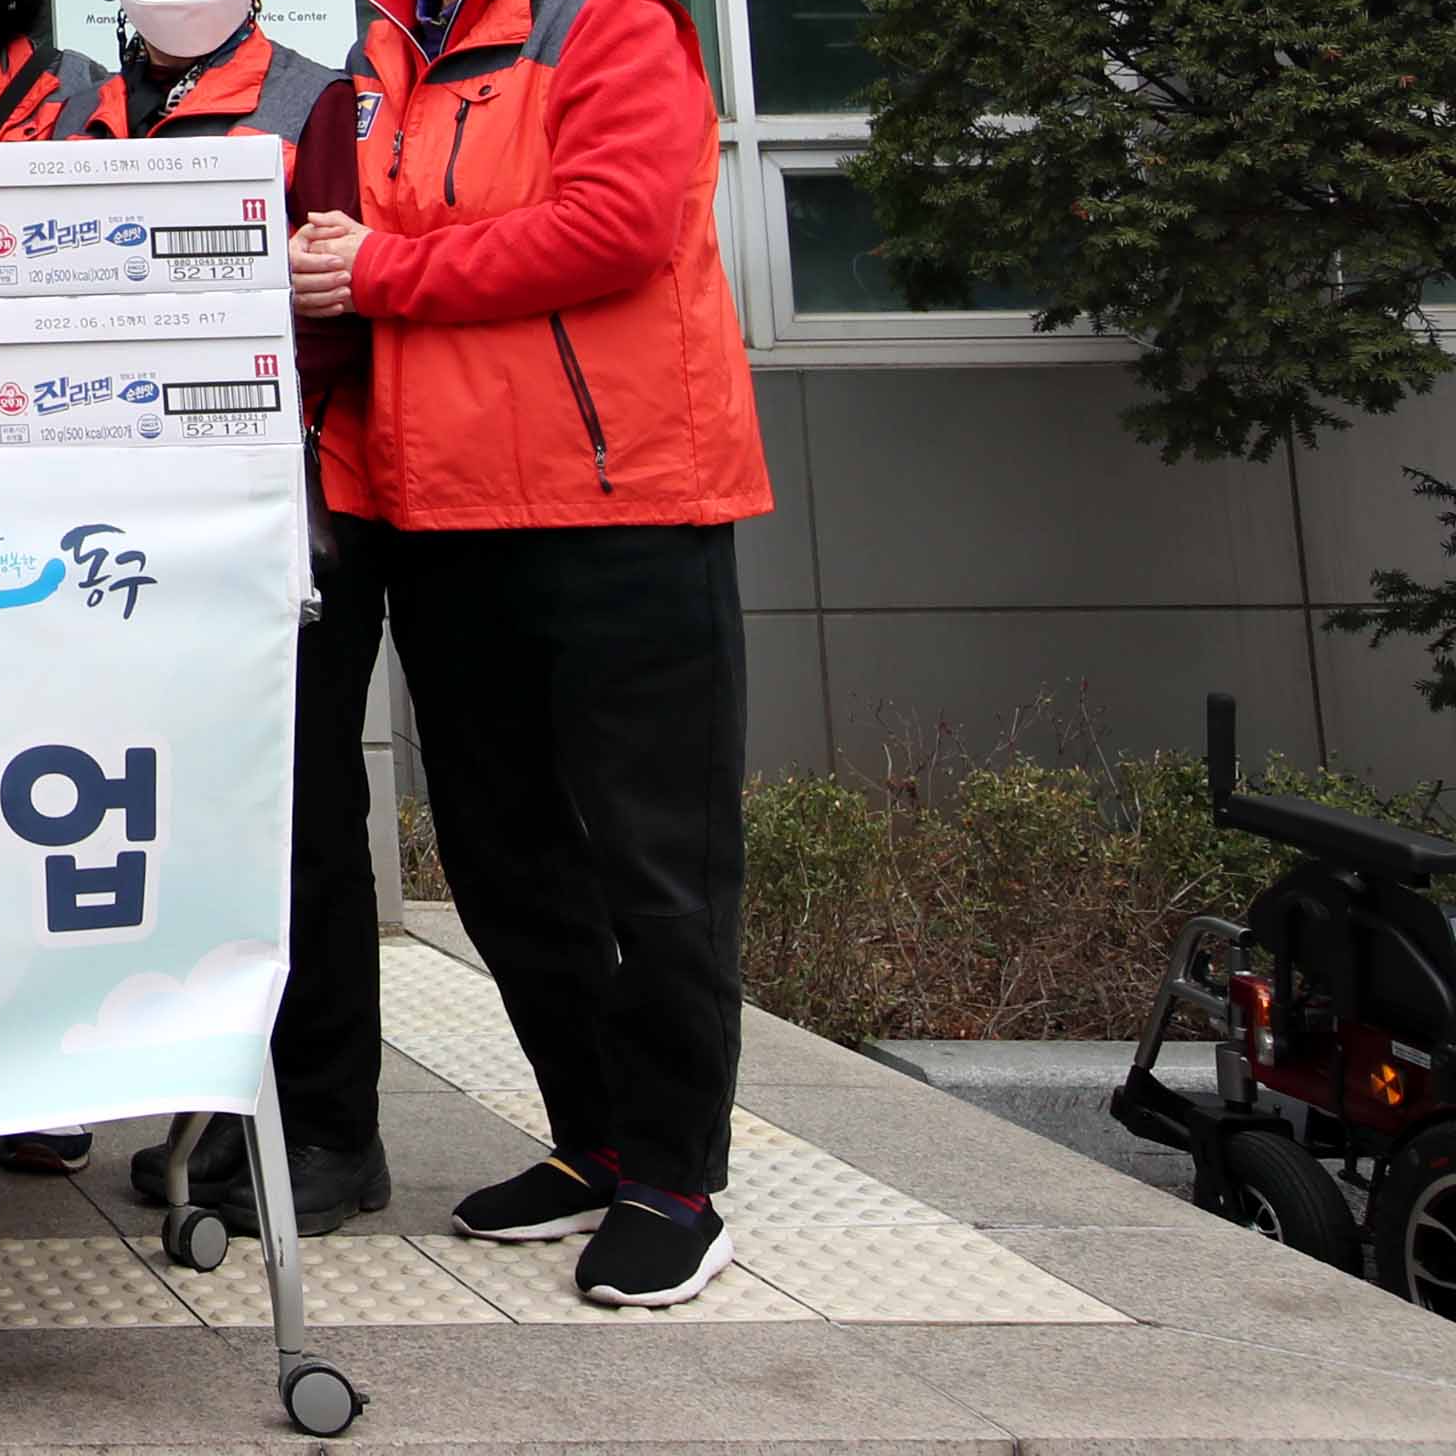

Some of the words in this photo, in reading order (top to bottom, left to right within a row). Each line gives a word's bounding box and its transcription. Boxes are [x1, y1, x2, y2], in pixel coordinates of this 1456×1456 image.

[288, 11, 327, 22] Center
[22, 219, 101, 258] 진라면
[33, 376, 113, 416] 진라면
[60, 523, 159, 620] 동구
